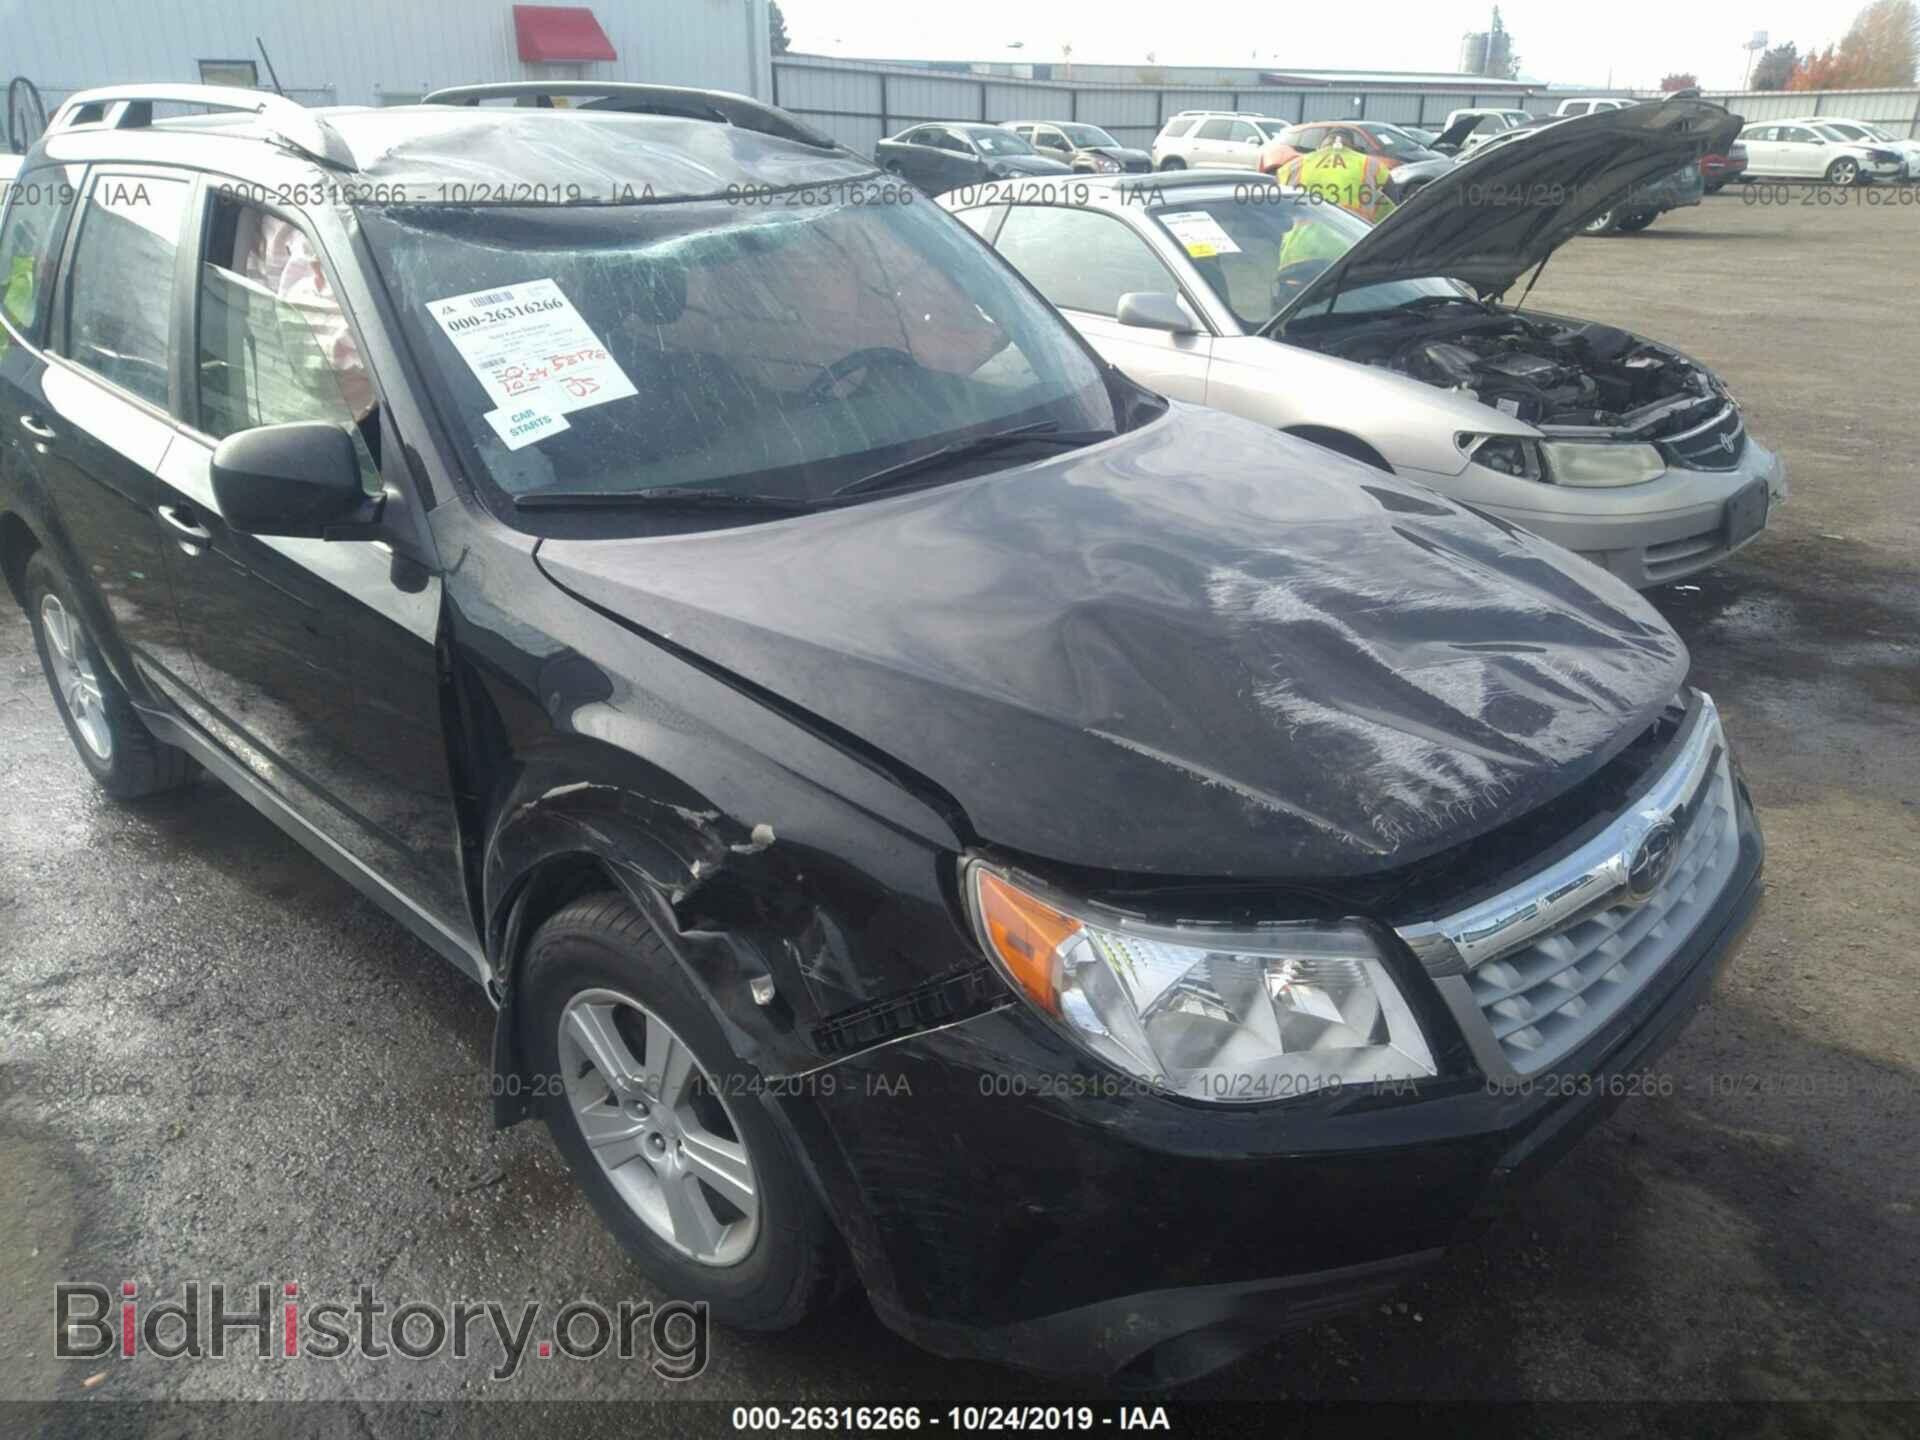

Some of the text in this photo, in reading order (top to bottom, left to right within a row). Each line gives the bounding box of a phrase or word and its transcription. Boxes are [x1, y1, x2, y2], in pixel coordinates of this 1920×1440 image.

[447, 297, 564, 333] 000-26316266
[510, 415, 553, 437] STARTS
[511, 408, 536, 423] CAR
